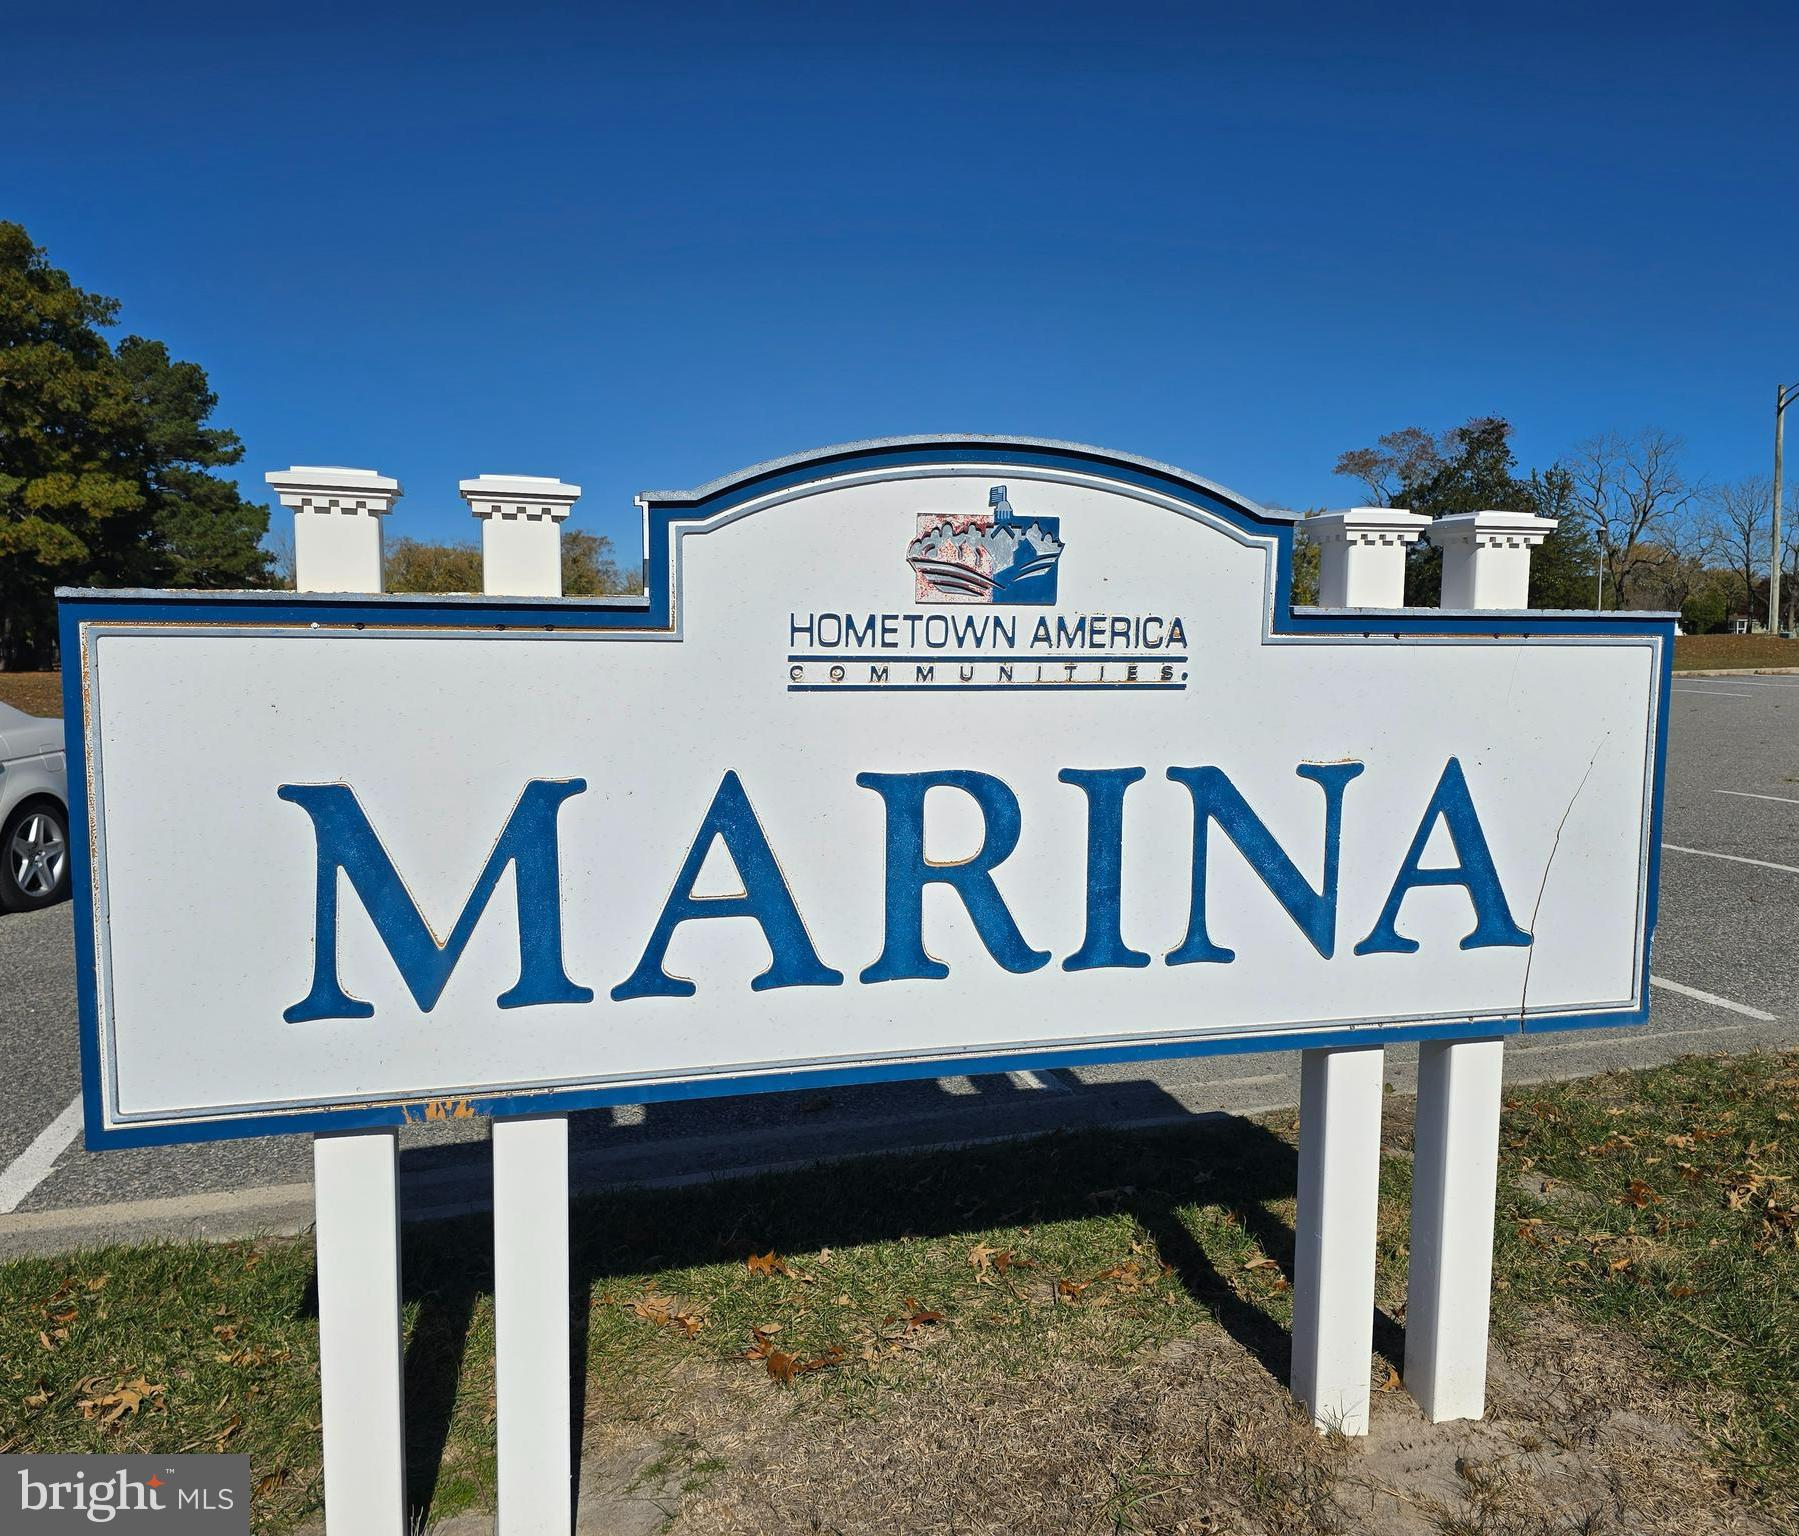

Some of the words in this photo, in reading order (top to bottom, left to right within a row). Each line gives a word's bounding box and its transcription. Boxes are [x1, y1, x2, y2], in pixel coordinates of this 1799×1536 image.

[790, 613, 1016, 649] HOMETOWN
[1030, 615, 1188, 649] AMERICA
[278, 758, 1532, 1022] MARINA
